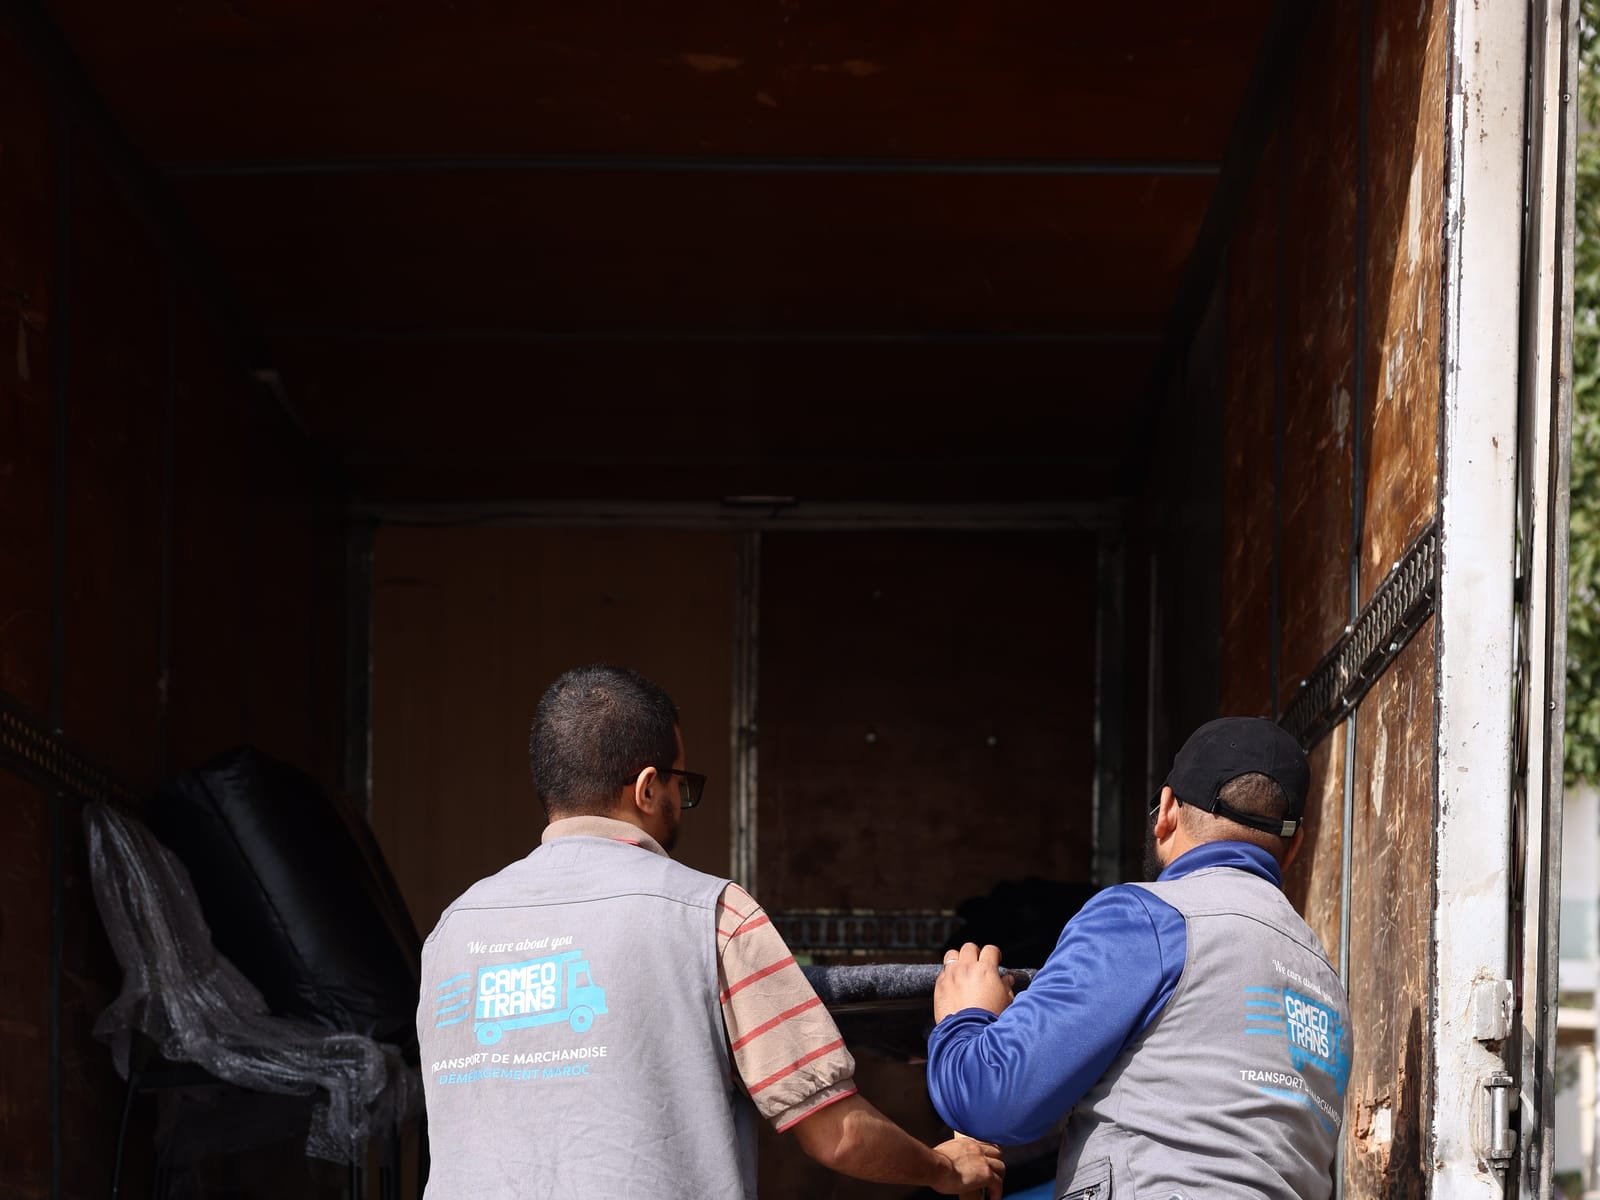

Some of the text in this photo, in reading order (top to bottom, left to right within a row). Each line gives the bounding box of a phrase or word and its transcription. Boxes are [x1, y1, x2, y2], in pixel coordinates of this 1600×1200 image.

[467, 935, 573, 954] We care about you
[480, 961, 556, 996] CAMEO
[479, 985, 556, 1019] TRANS
[1285, 995, 1328, 1033] CAMEO
[1287, 1019, 1329, 1058] TRANS
[491, 1053, 510, 1064] DE
[513, 1046, 607, 1065] MARCHANDISE
[542, 1064, 590, 1079] MAROC
[1240, 1070, 1304, 1089] TRANSPORT
